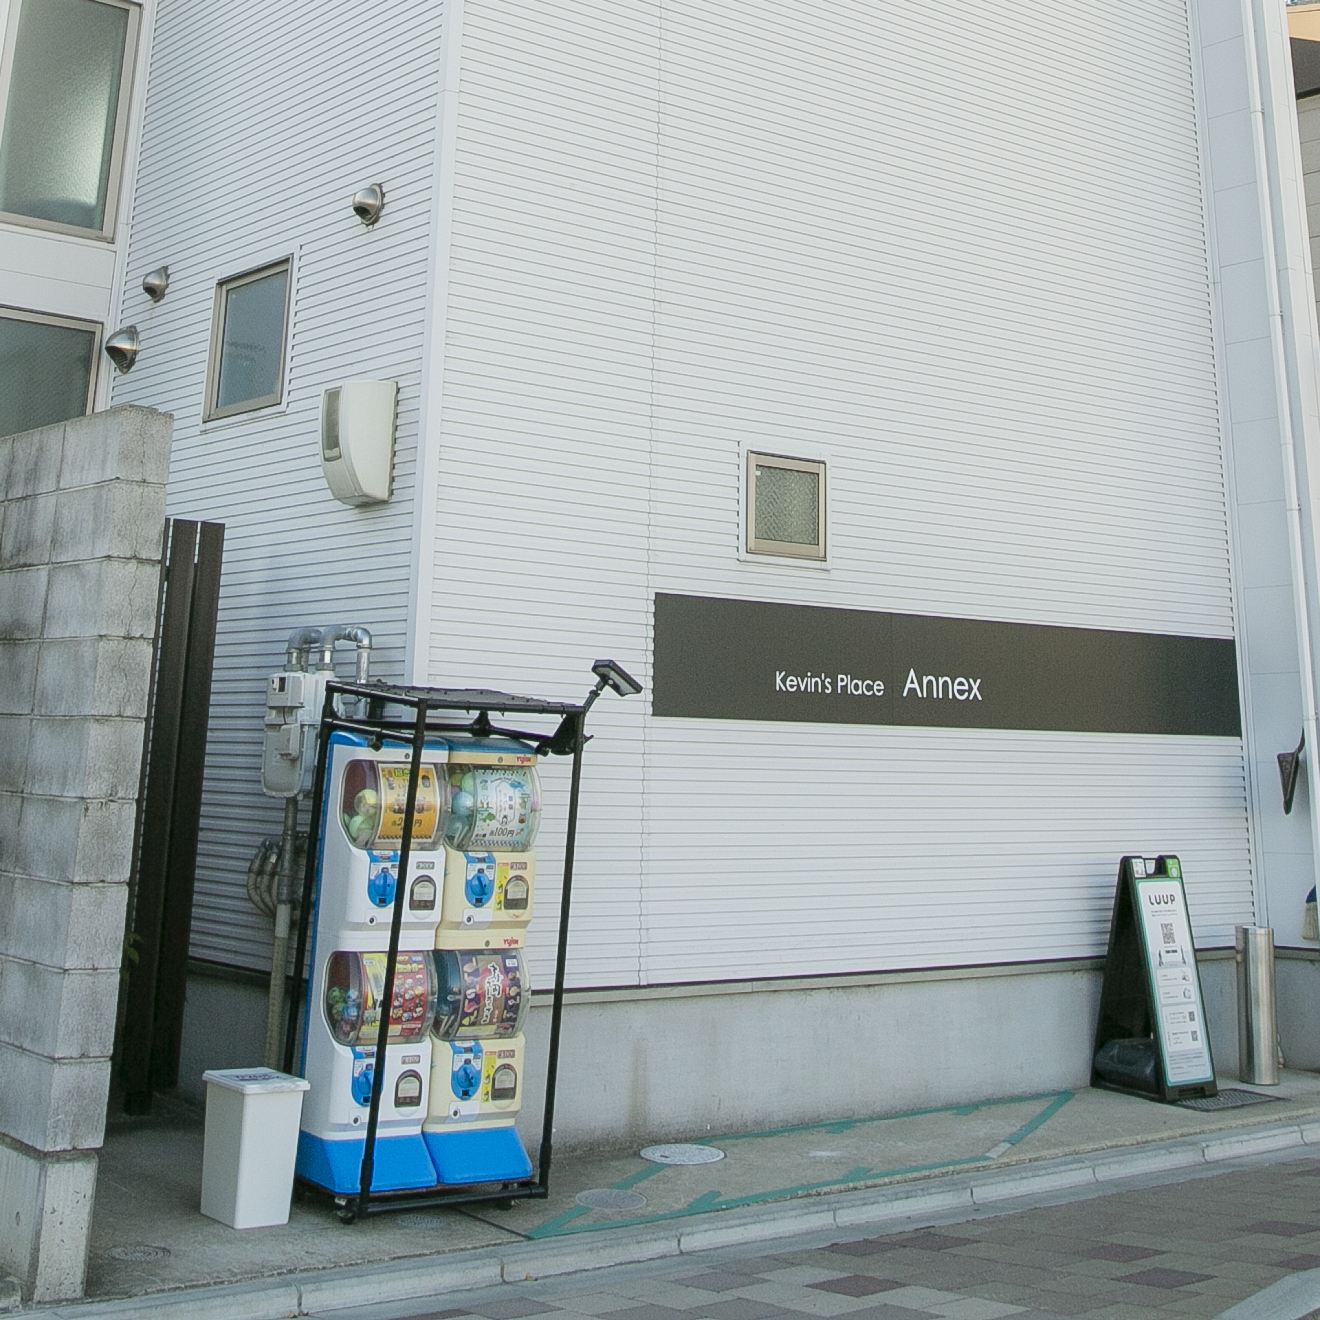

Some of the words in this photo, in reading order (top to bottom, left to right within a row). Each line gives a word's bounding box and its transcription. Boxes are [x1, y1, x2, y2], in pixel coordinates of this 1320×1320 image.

[775, 670, 832, 694] Kevin's
[837, 674, 885, 696] Place
[902, 668, 983, 701] Annex
[1148, 893, 1176, 906] LUUP
